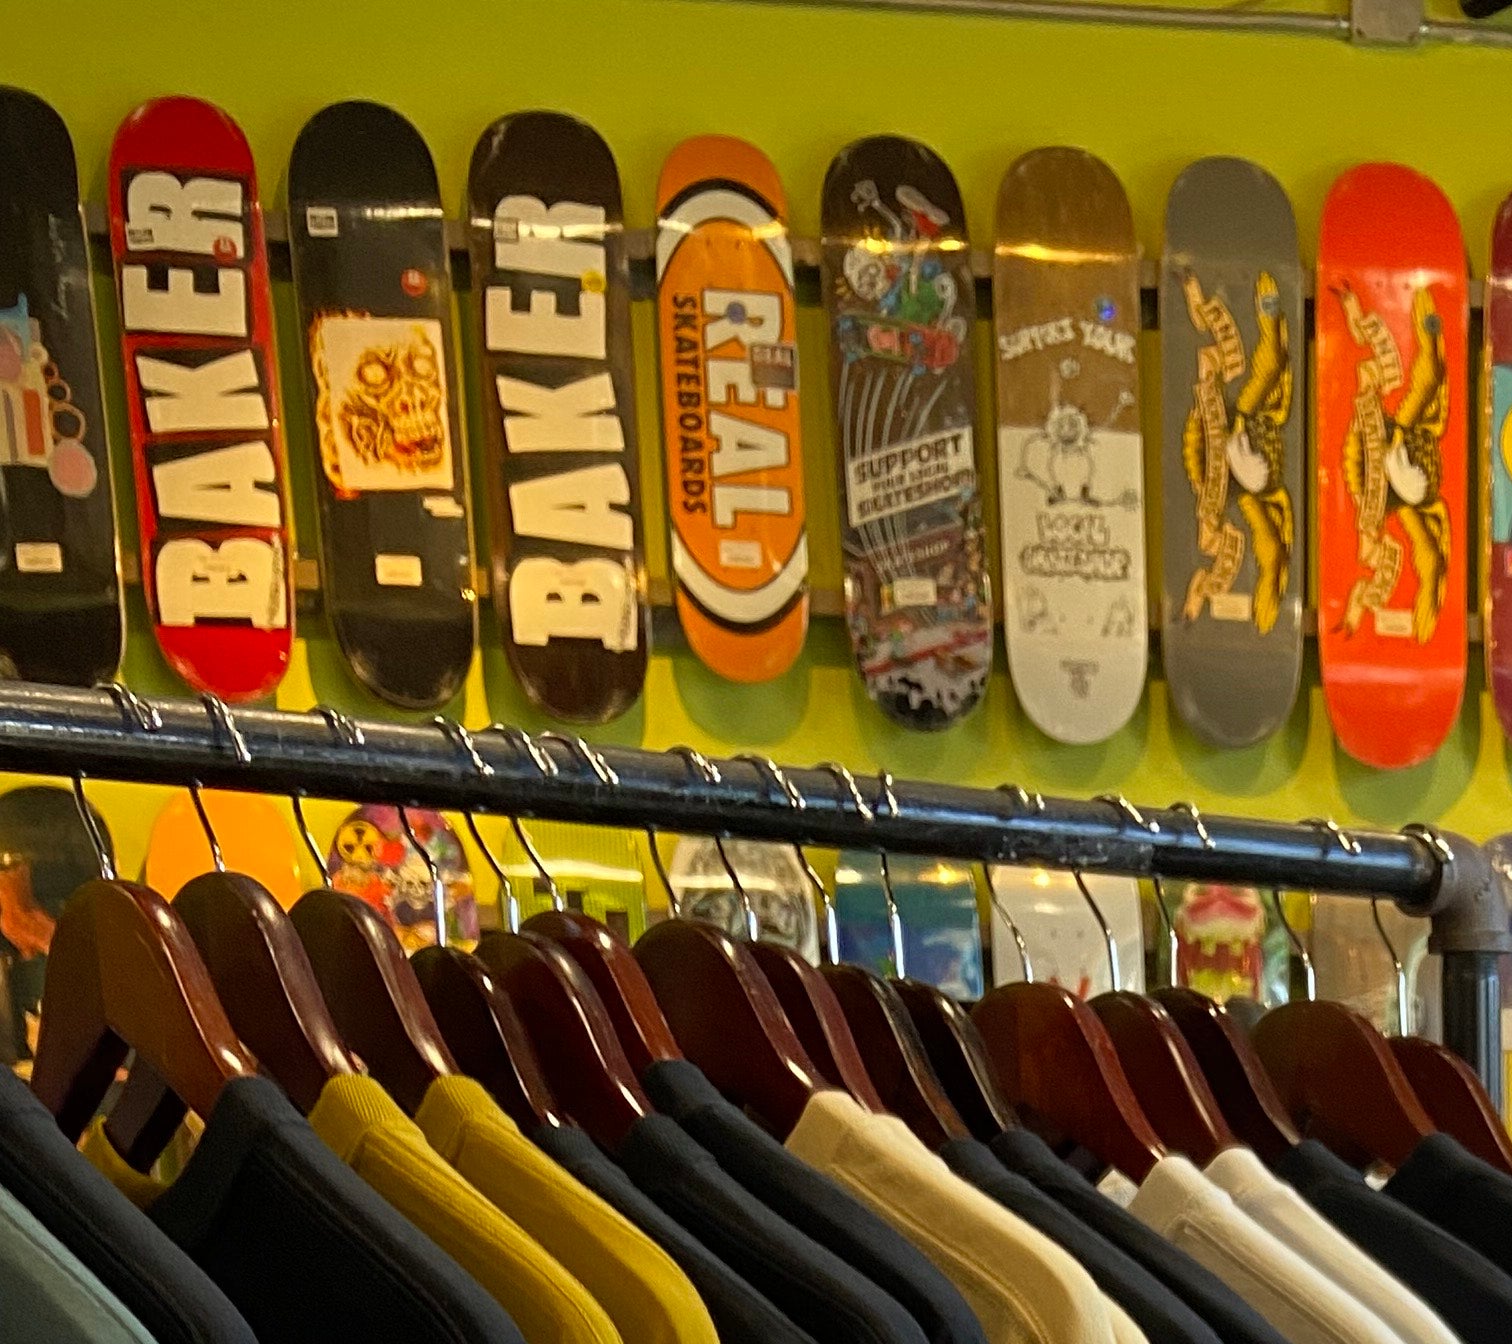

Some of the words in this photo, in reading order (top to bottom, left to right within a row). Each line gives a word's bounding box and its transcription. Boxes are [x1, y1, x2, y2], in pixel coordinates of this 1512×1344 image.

[122, 171, 287, 630] BAKER
[485, 194, 639, 652] BAKER
[672, 294, 707, 515] SKATEBOARDS
[703, 288, 792, 528] REAL
[854, 432, 962, 484] SUPPORT
